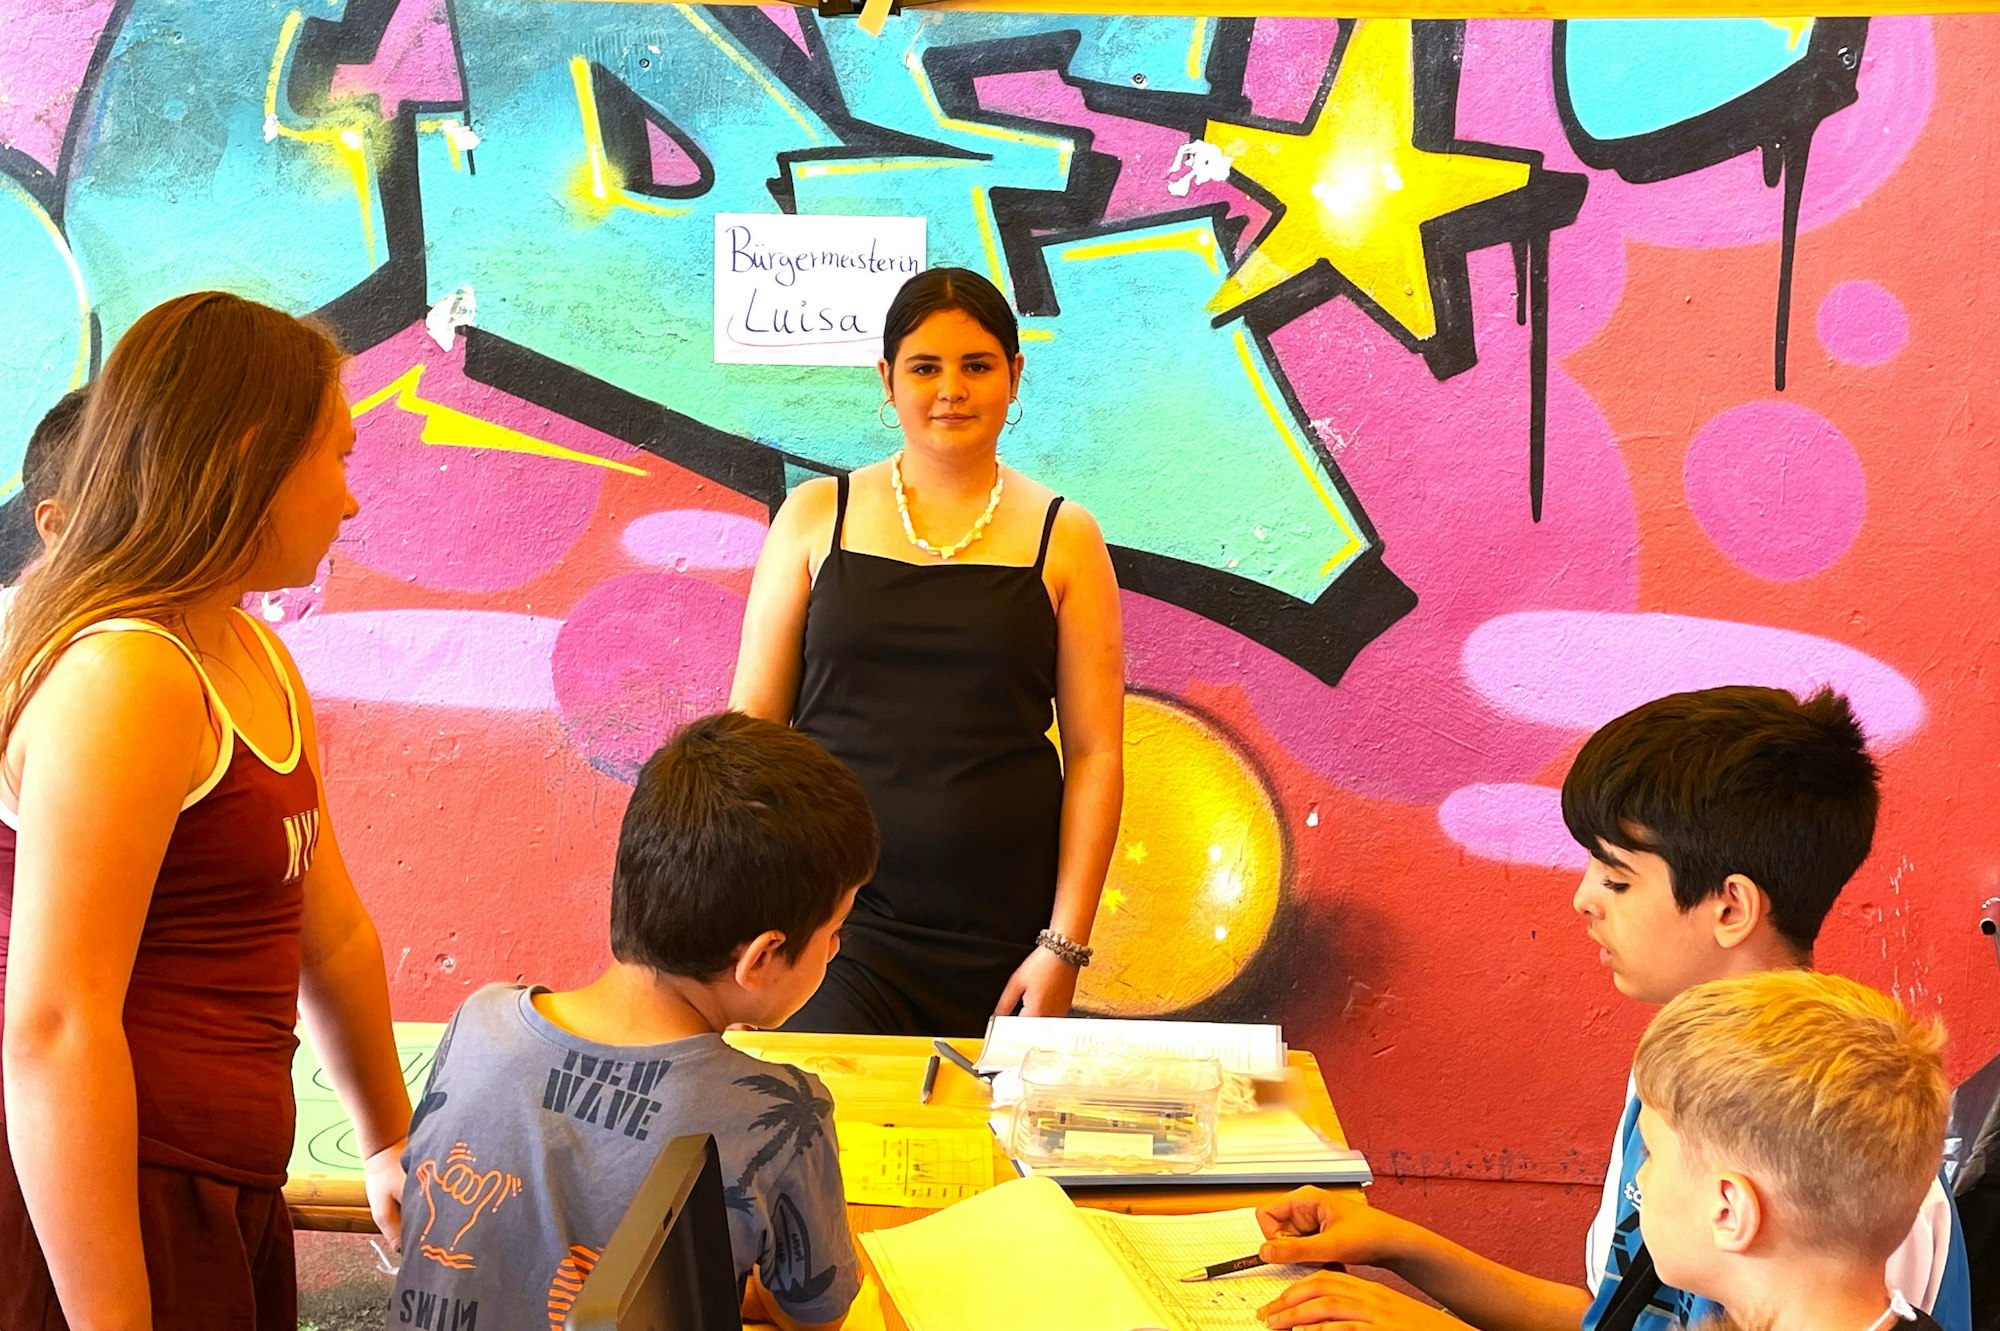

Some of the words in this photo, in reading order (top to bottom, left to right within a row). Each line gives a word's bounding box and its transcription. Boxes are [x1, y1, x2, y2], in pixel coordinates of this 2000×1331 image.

[724, 225, 919, 287] Bürgermeisterin
[745, 288, 868, 335] Luisa
[562, 1049, 673, 1097] NEW
[542, 1067, 663, 1142] WAVE
[399, 1289, 479, 1331] SWIM
